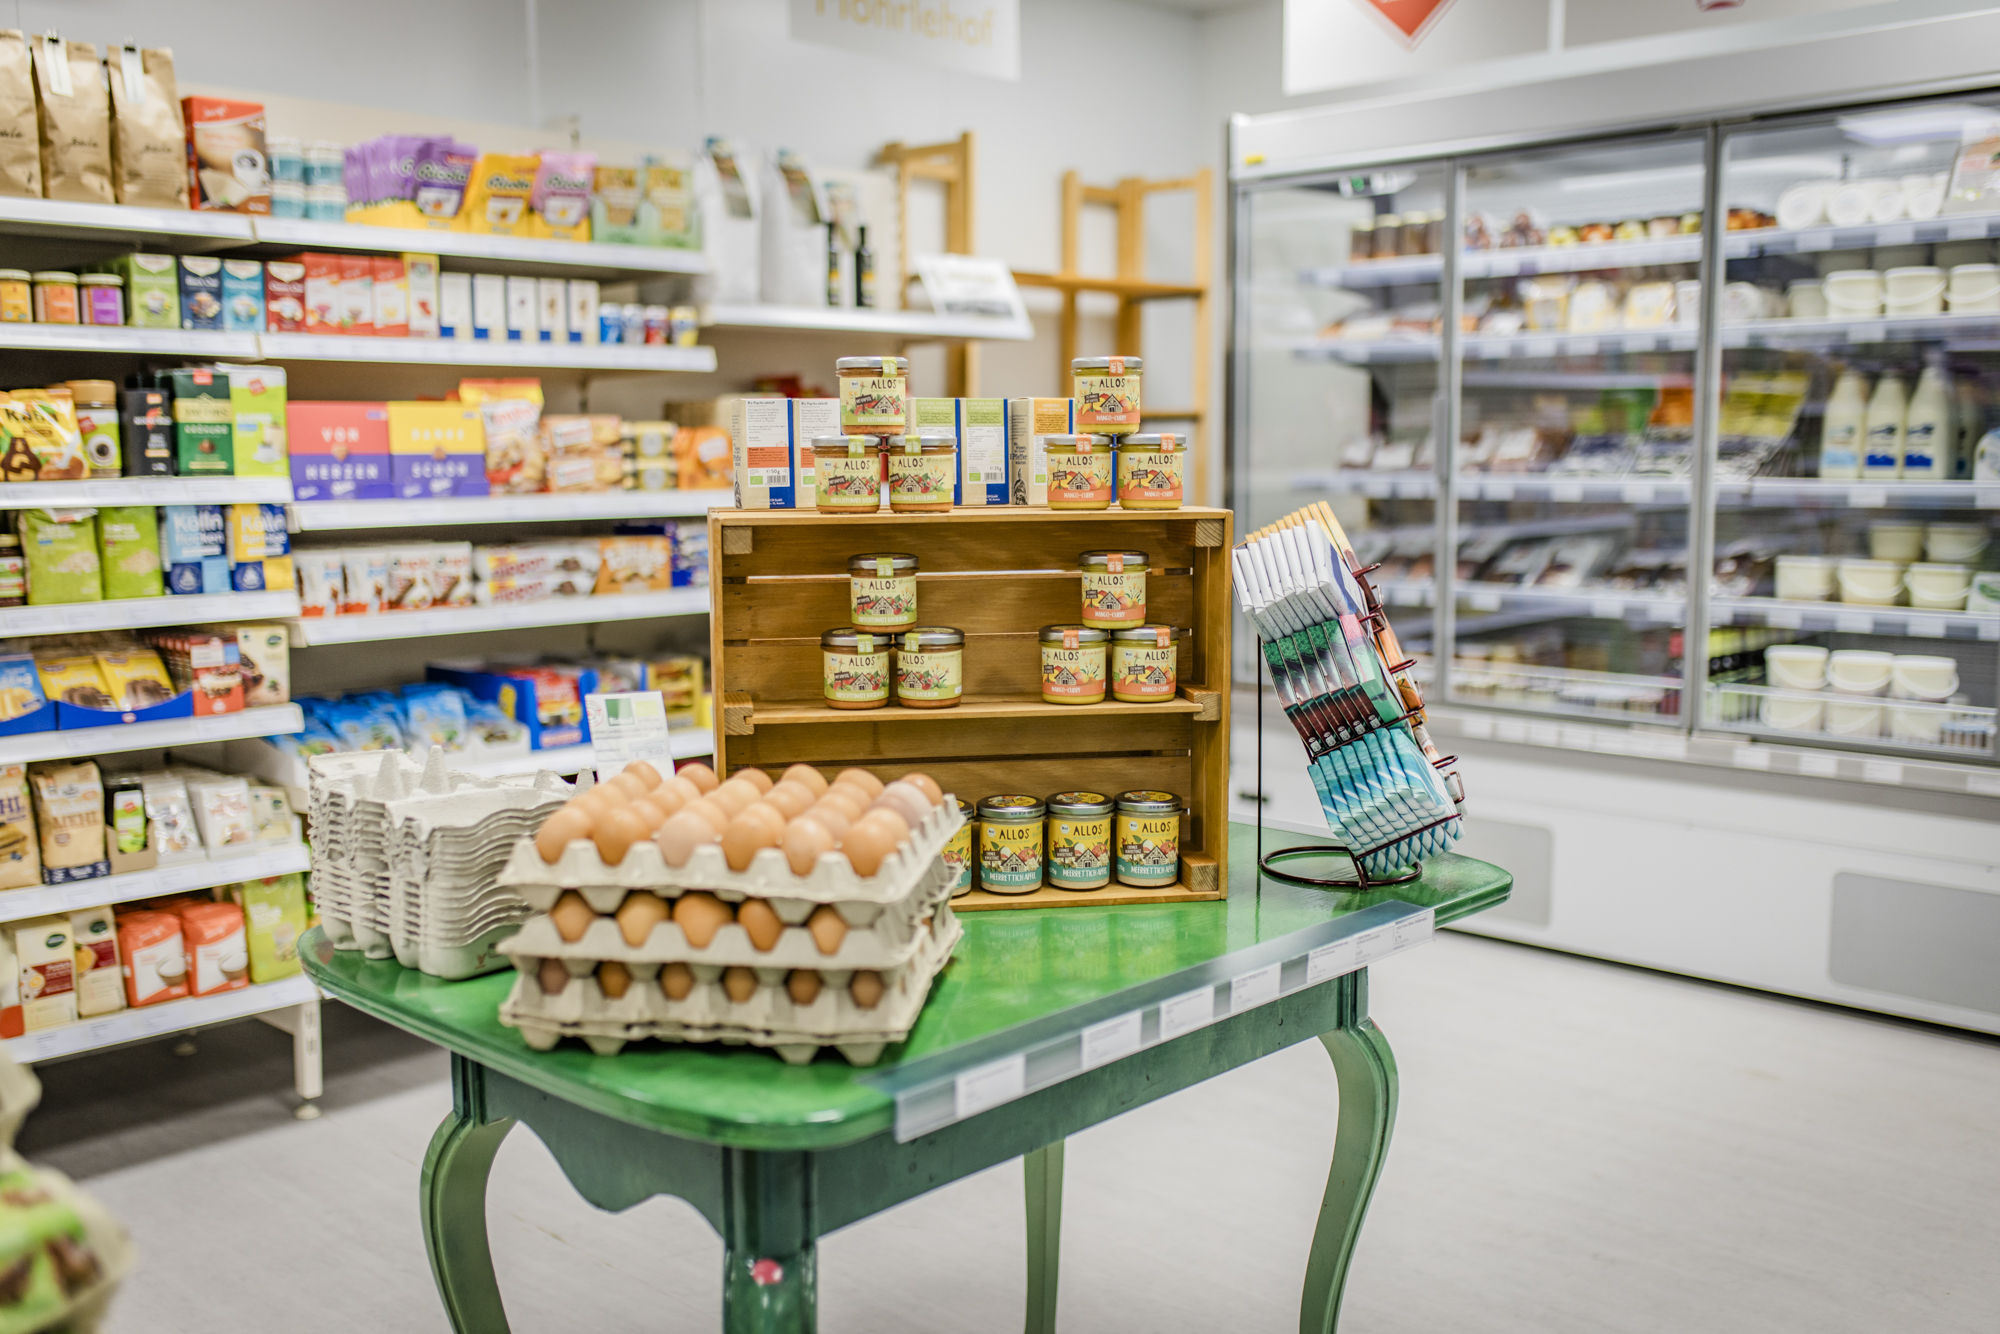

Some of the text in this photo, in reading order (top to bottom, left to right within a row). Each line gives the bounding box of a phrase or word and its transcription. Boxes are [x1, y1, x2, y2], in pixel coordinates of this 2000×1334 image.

[871, 380, 897, 389] ALLOS
[1099, 379, 1125, 388] ALLOS
[898, 458, 924, 468] ALLOS
[1066, 456, 1093, 465] ALLOS
[1148, 455, 1173, 464] ALLOS
[844, 460, 870, 470] ALLOS
[869, 580, 896, 590] ALLOS
[1098, 576, 1124, 585] ALLOS
[902, 655, 925, 664] ALLOS
[1054, 652, 1079, 661] ALLOS
[1145, 651, 1169, 660] ALLOS
[849, 657, 875, 666] ALLOS
[1073, 824, 1102, 836] ALLOS
[1142, 822, 1171, 833] ALLOS
[999, 829, 1030, 840] ALLOS
[1063, 867, 1107, 878] MEERRETTICH APFEL
[1131, 865, 1175, 874] MEERRETTICH APFEL
[990, 872, 1036, 881] MEERRETTICH APFEL
